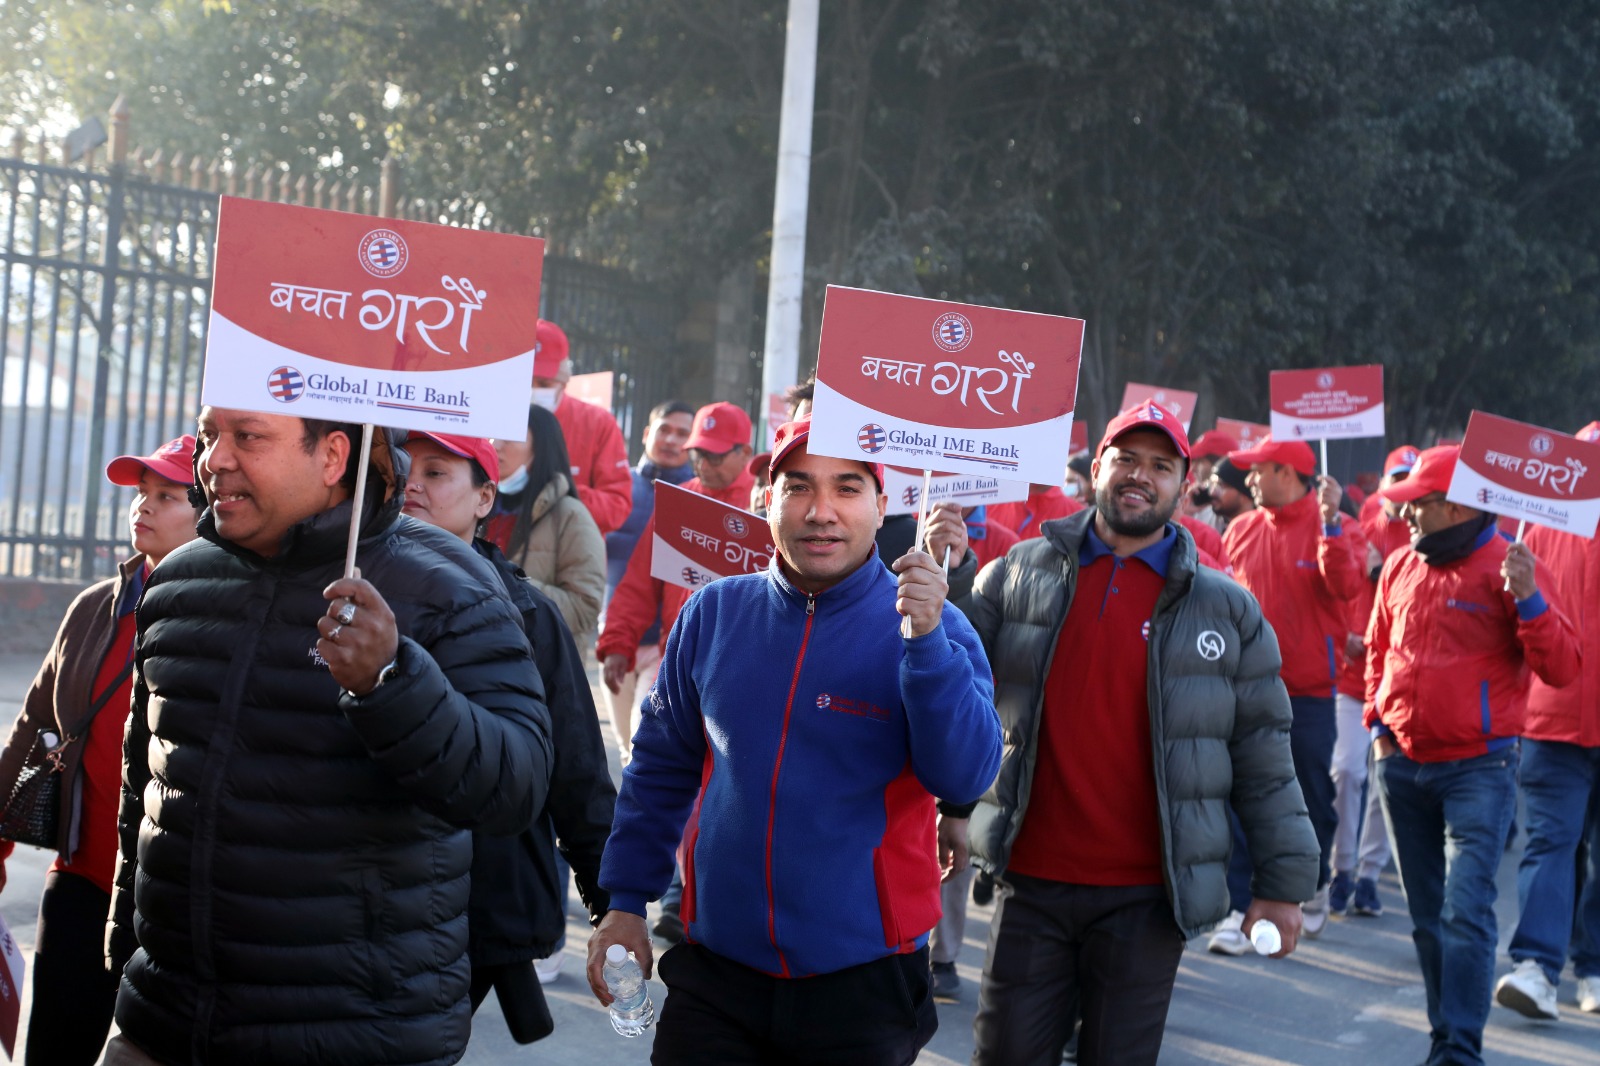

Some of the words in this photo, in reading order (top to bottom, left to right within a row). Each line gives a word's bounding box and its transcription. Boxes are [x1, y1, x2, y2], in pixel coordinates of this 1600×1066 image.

[269, 282, 352, 319] बचत
[861, 356, 926, 386] बचत
[307, 373, 368, 395] Global
[376, 381, 416, 401] IME
[424, 387, 470, 408] Bank
[888, 430, 937, 448] Global
[942, 436, 975, 453] IME
[981, 441, 1020, 459] Bank
[1484, 449, 1524, 472] बचत
[920, 482, 949, 496] lobal
[952, 480, 973, 492] IME
[975, 478, 999, 490] Bank
[1495, 491, 1523, 507] Global
[1525, 500, 1545, 512] IME
[1547, 506, 1570, 519] Bank
[680, 526, 721, 553] बचत
